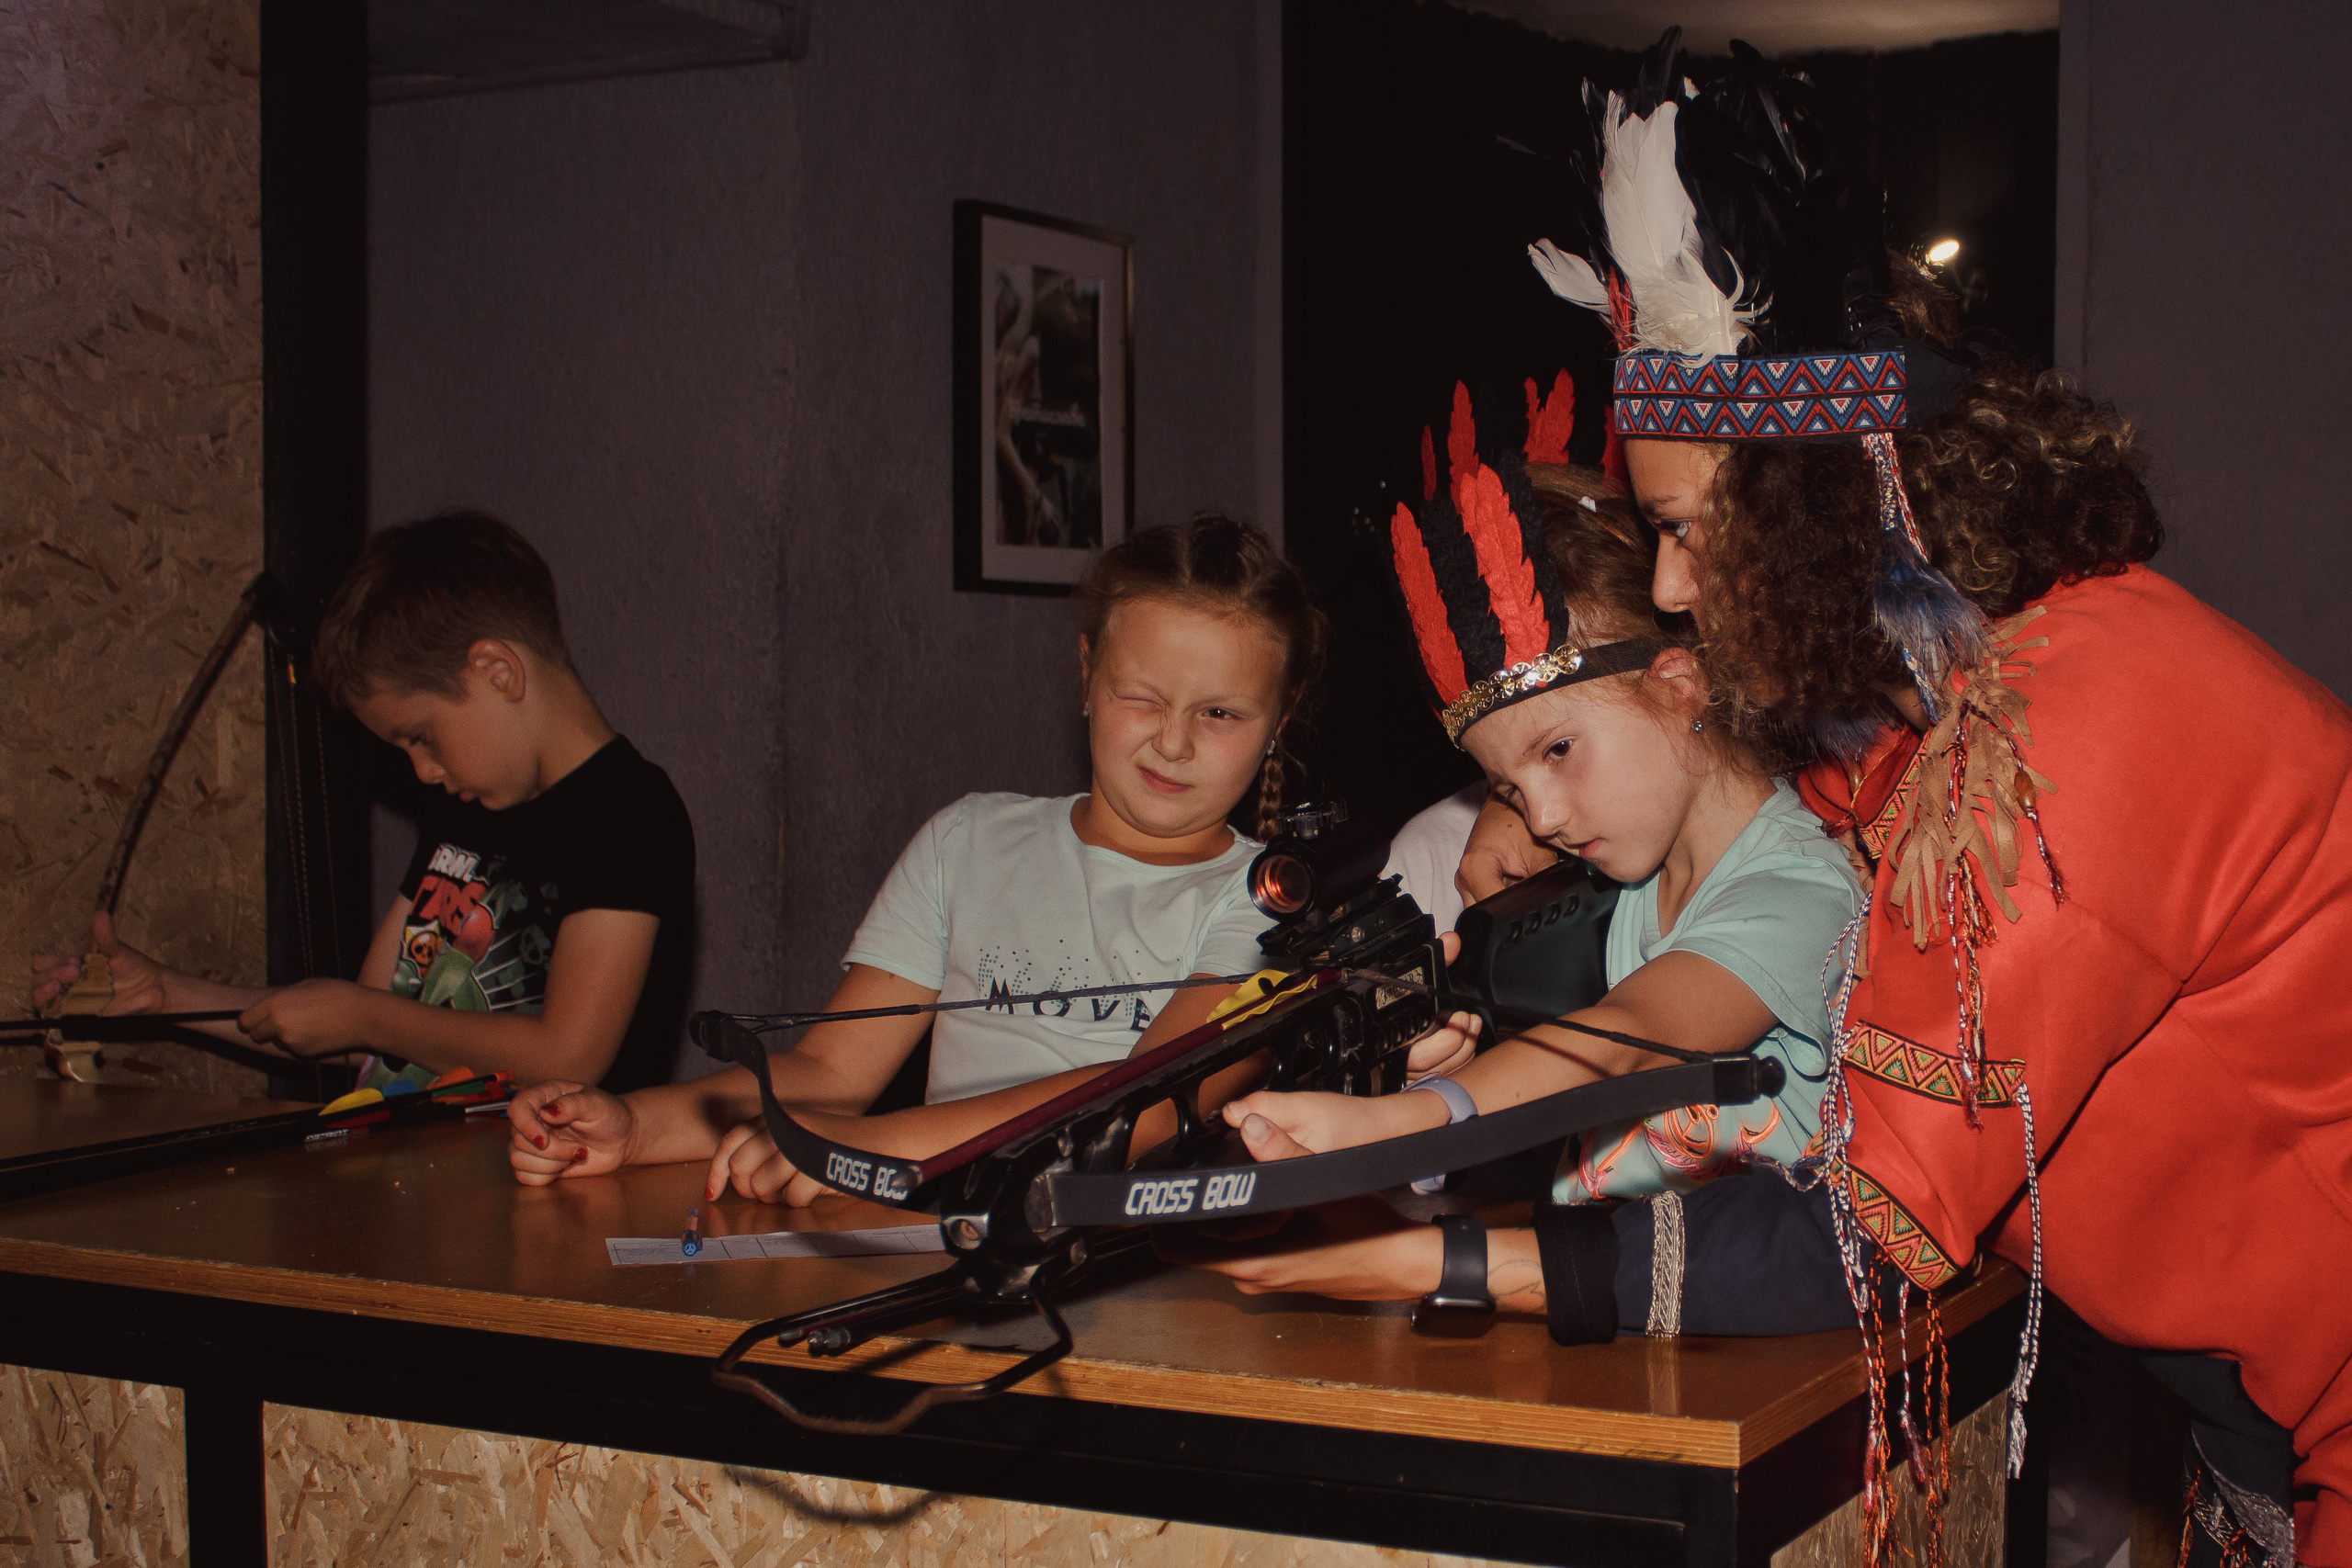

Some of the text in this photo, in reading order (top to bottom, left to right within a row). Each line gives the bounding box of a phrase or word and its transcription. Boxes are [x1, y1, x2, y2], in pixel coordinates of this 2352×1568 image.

[827, 1152, 872, 1191] CROSS
[1125, 1171, 1257, 1216] CROSS BOW
